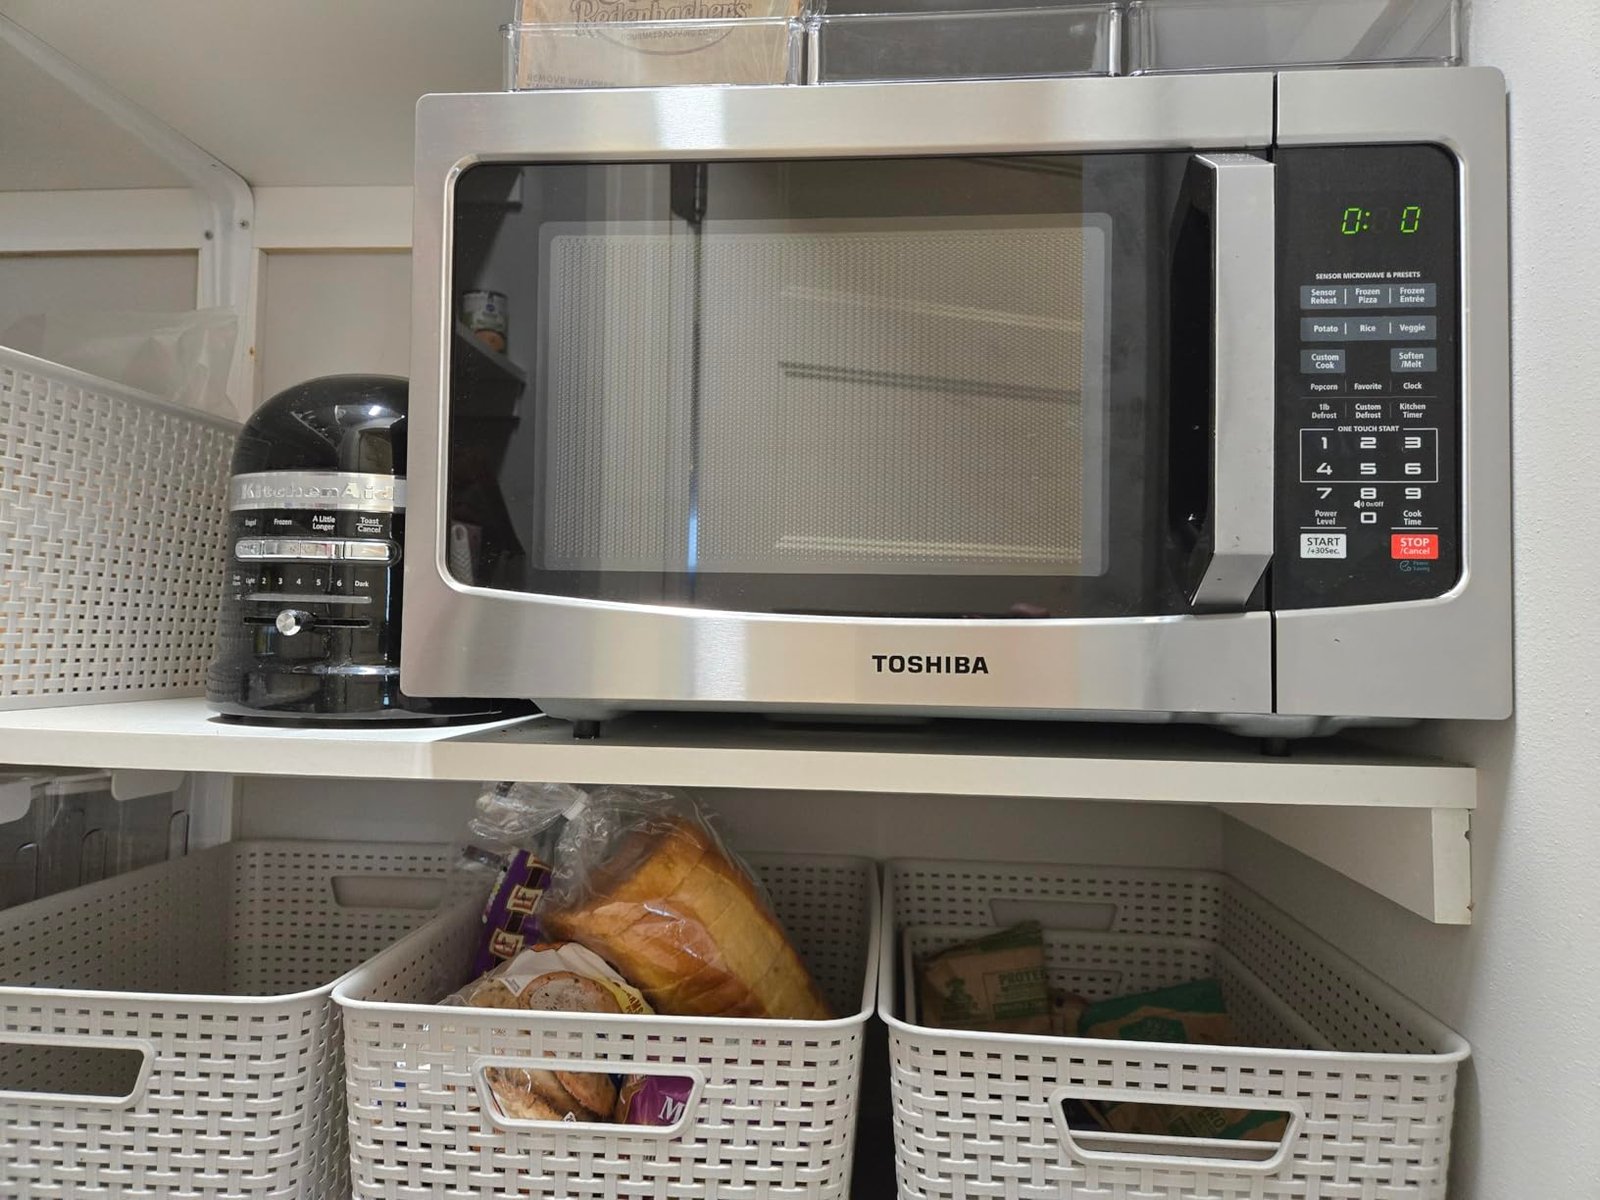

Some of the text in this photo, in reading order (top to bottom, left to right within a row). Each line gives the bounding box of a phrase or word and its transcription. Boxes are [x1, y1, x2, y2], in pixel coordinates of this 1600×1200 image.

[1315, 272, 1342, 280] SENSOR
[1342, 271, 1385, 280] MICROWAVE
[1392, 271, 1421, 279] PRESETS
[1311, 288, 1336, 296] Sensor
[1355, 287, 1381, 296] Frozen
[1399, 286, 1425, 295] Frozen
[1310, 296, 1337, 305] Reheat
[1358, 296, 1378, 304] Pizza
[1399, 295, 1425, 303] Entrée
[1313, 324, 1339, 333] Potato
[1359, 324, 1377, 332] Rice
[1399, 323, 1426, 333] Veggie
[1311, 353, 1339, 361] Custom
[1398, 352, 1424, 360] Soften
[1315, 361, 1335, 369] Cook
[1401, 360, 1422, 368] /Melt
[1310, 383, 1339, 391] Popcorn
[1354, 382, 1382, 390] Favorite
[1402, 381, 1422, 390] Clock
[1355, 403, 1382, 411] Custom
[1399, 402, 1426, 410] Kitchen
[1311, 411, 1337, 419] Defrost
[1355, 411, 1382, 419] Defrost
[1402, 411, 1423, 419] Timer
[1337, 425, 1352, 433] ONE
[1353, 425, 1378, 433] TOUCH
[1321, 436, 1328, 450] 1
[1359, 436, 1377, 449] 2
[1404, 436, 1422, 449] 3
[1316, 462, 1333, 475] 4
[1360, 462, 1377, 475] 5
[1404, 462, 1422, 475] 6
[1316, 487, 1333, 499] 7
[1360, 487, 1377, 500] 8
[1404, 487, 1422, 500] 9
[1314, 510, 1338, 518] Power
[1360, 511, 1377, 524] 0
[1403, 509, 1422, 518] Cook
[273, 518, 293, 526] Frozen
[318, 515, 336, 523] Little
[360, 517, 379, 525] Toast
[1403, 518, 1422, 526] Time
[312, 523, 335, 532] Longer
[357, 525, 382, 533] Cancel
[1307, 537, 1341, 546] START
[1400, 537, 1430, 547] STOP
[1400, 546, 1430, 555] /Cancel
[261, 577, 267, 585] 2
[278, 577, 283, 585] 3
[872, 655, 989, 674] TOSHIBA
